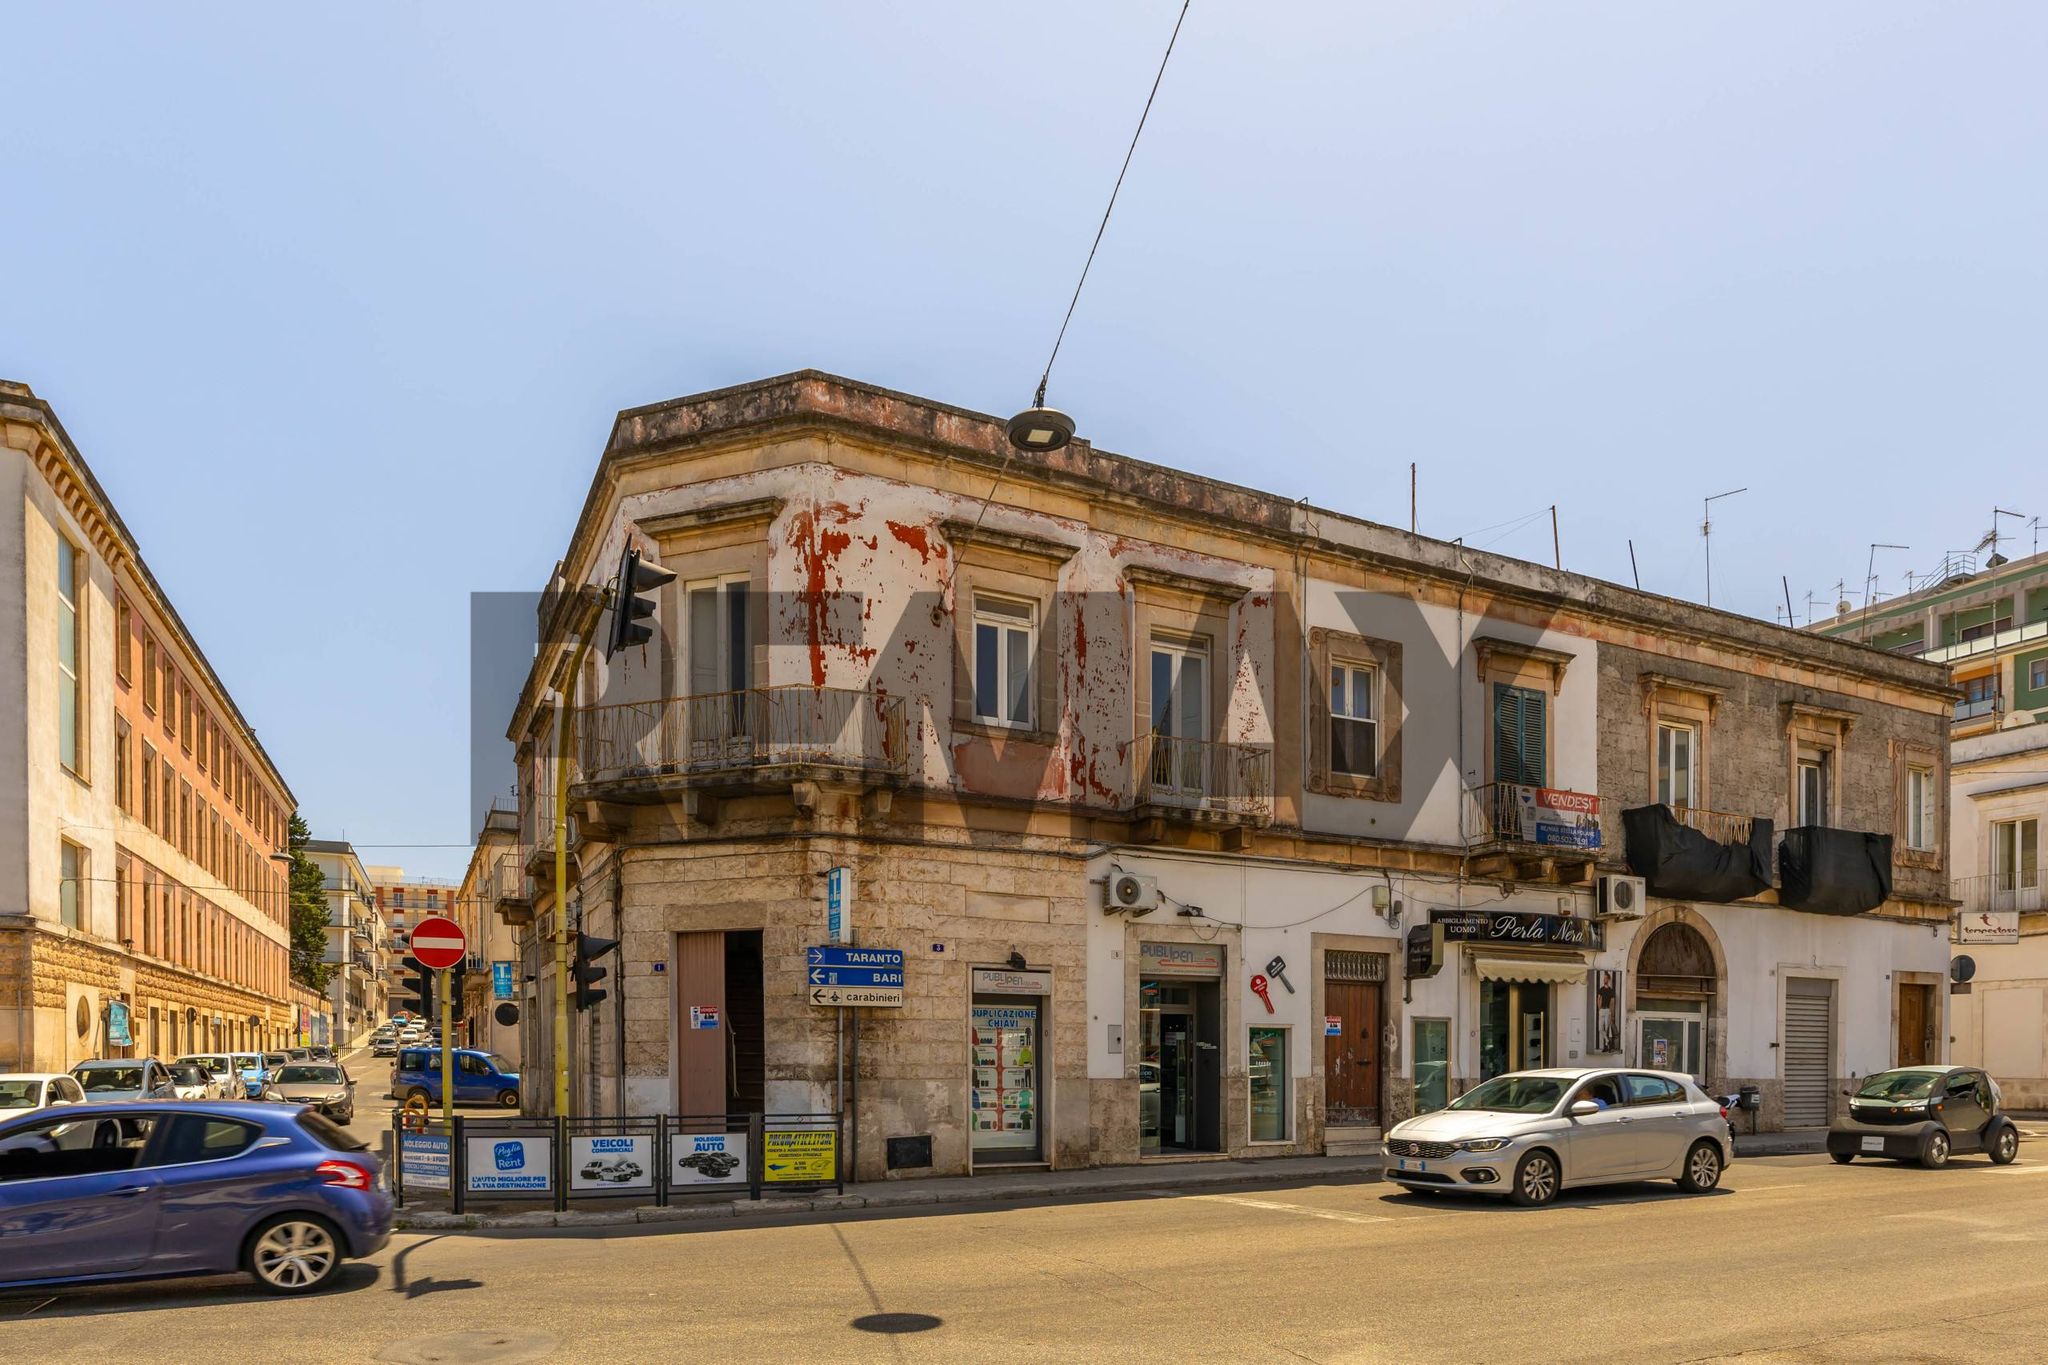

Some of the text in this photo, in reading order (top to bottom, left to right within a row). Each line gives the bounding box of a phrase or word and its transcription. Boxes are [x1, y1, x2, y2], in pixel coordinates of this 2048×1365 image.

[1490, 915, 1584, 942] Perla Nera
[846, 952, 901, 963] TARANTO
[873, 973, 902, 983] BARI
[846, 991, 901, 1003] carabinieri
[988, 1019, 1019, 1028] CHIAVI
[404, 1140, 448, 1150] NOLEGGIO AUTO
[591, 1138, 634, 1147] VEICOLI
[694, 1142, 725, 1152] AUTO
[495, 1143, 521, 1157] Puglia
[498, 1158, 522, 1169] Rent
